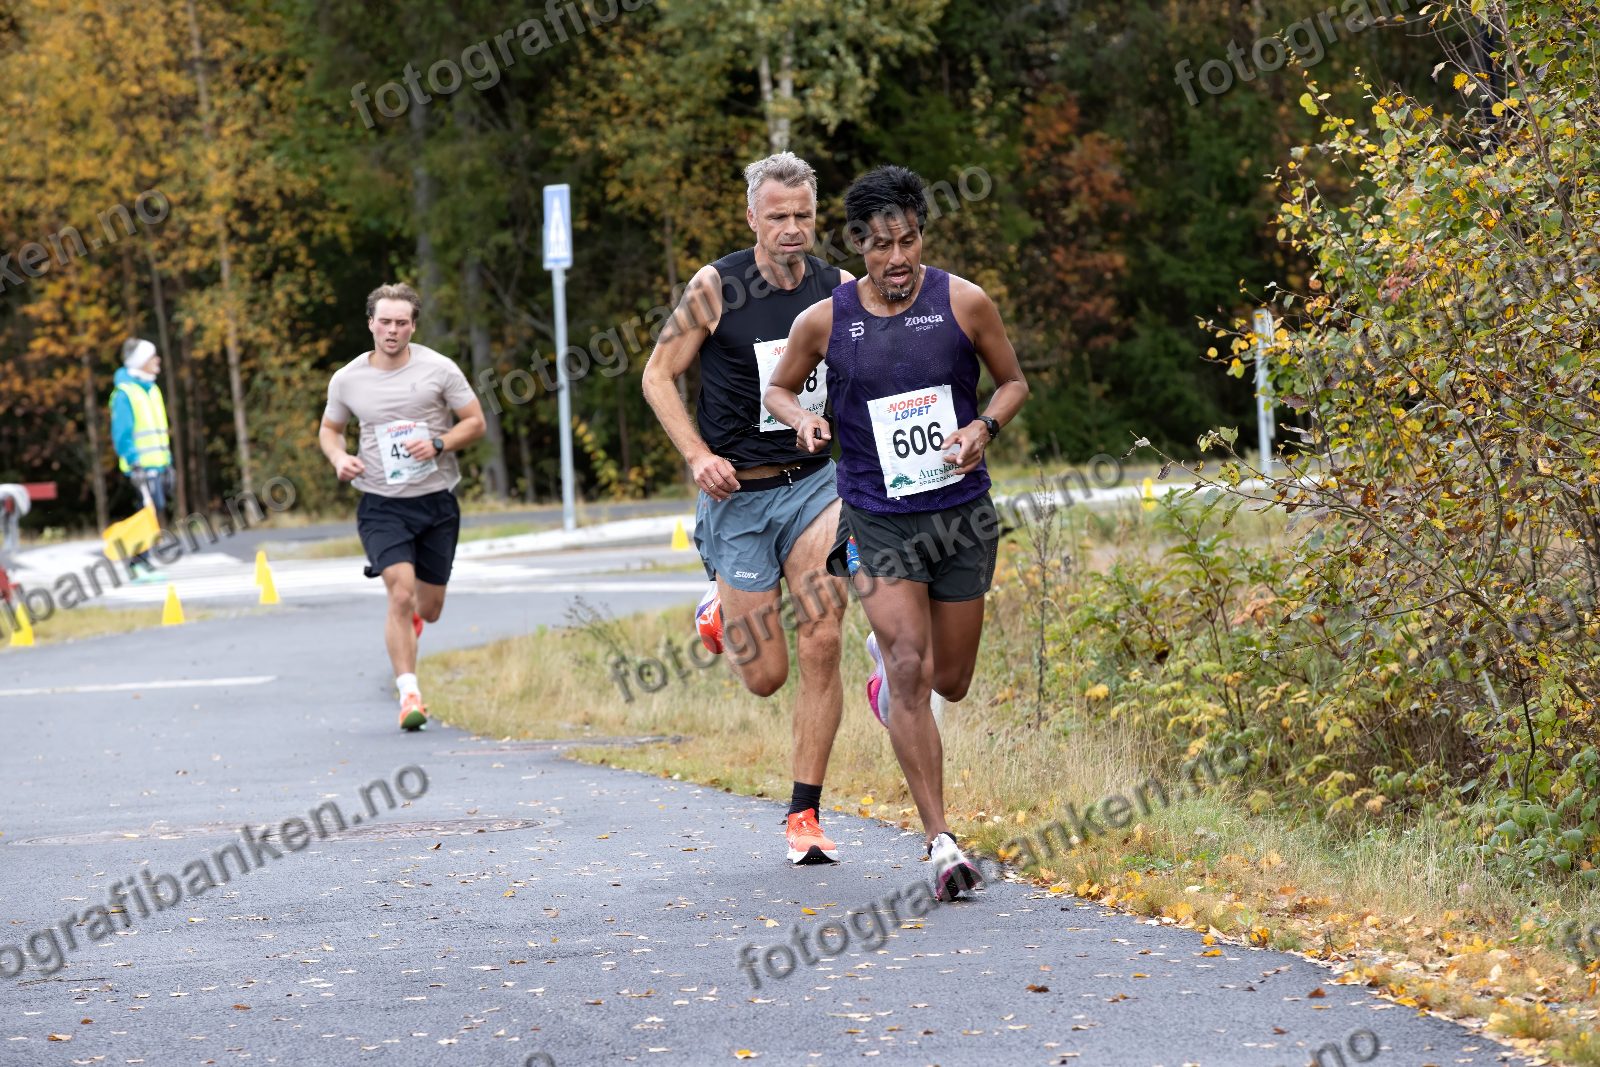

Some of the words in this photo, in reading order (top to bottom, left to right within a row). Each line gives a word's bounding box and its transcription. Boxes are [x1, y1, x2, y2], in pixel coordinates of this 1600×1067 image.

[904, 314, 944, 327] zooca
[888, 394, 938, 412] NORGES
[894, 405, 931, 421] LØPET
[892, 421, 944, 459] 606
